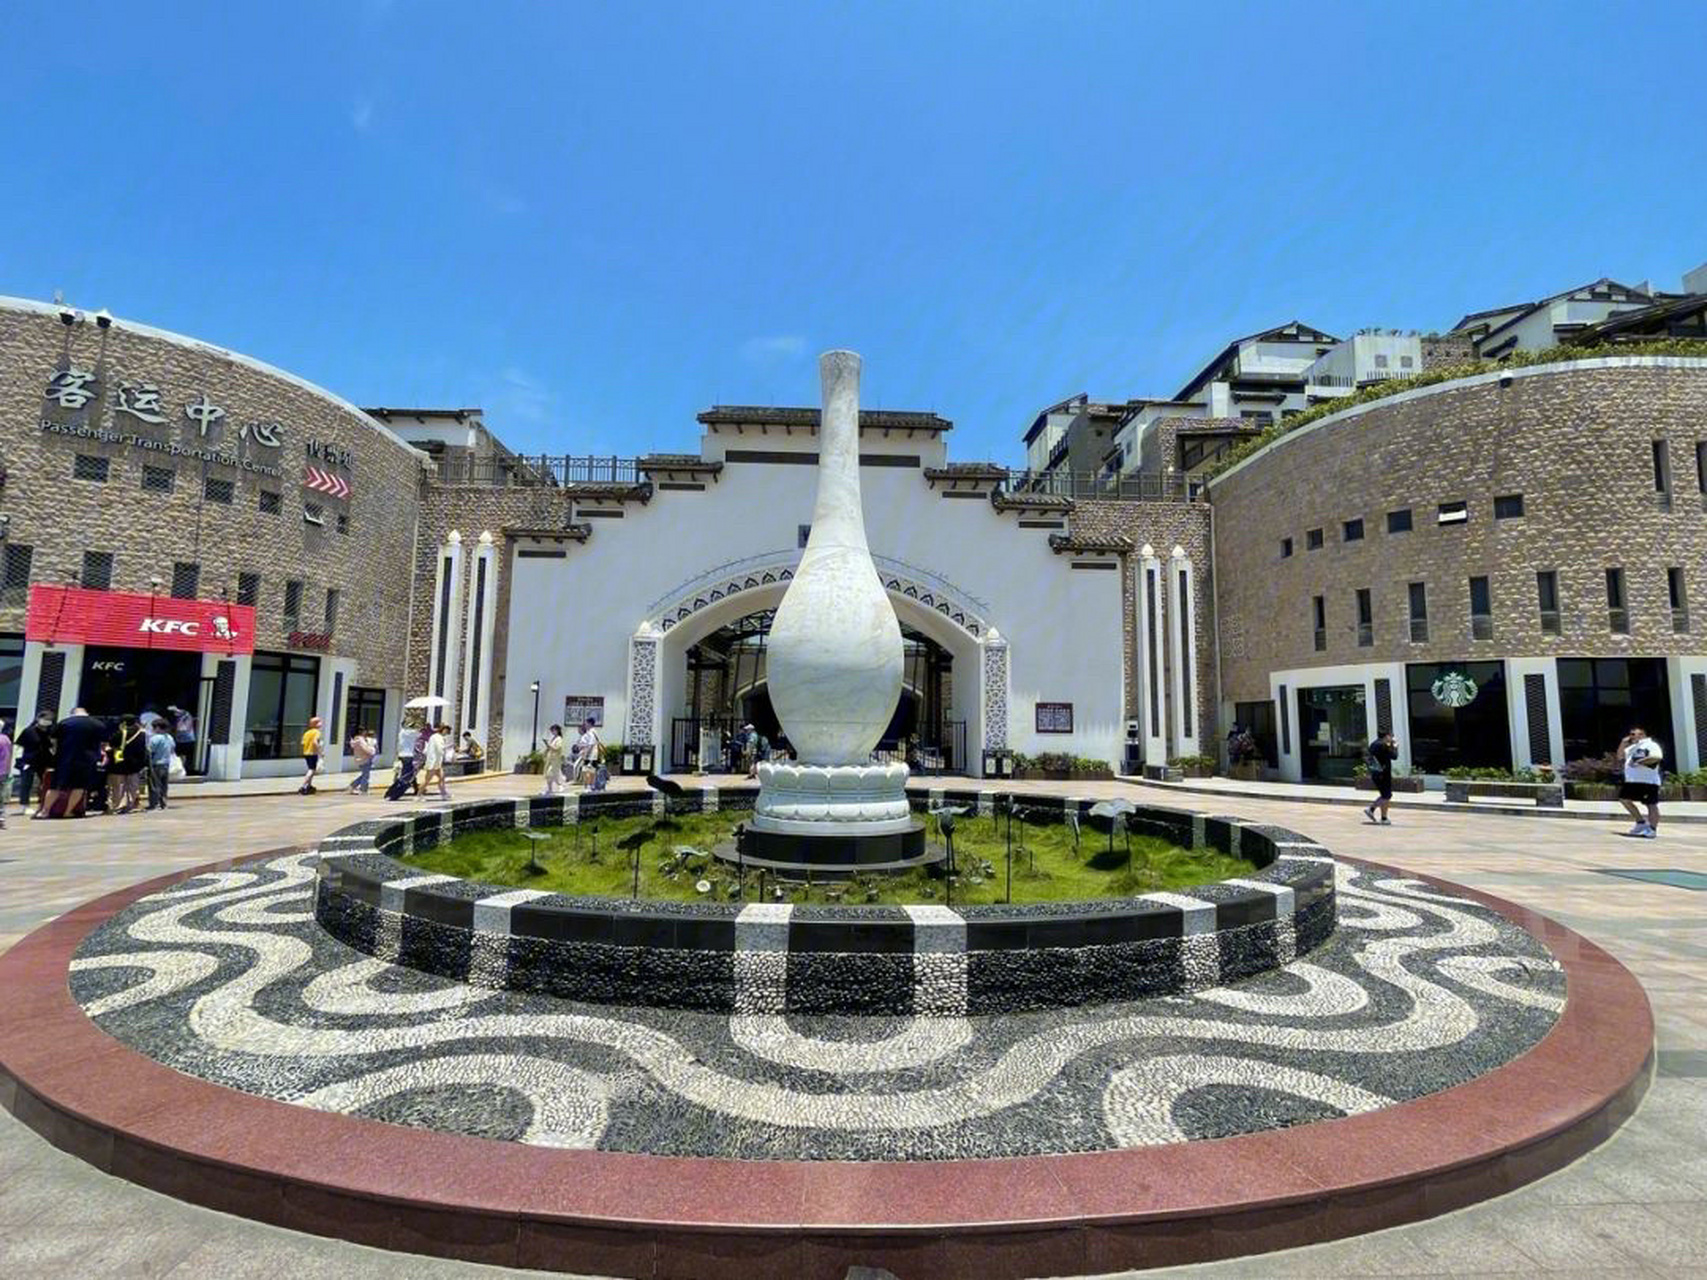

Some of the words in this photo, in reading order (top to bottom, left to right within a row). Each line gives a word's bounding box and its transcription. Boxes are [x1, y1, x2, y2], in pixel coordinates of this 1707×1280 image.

[45, 367, 285, 447] 客运中心
[41, 419, 124, 443] Passenger
[130, 433, 239, 466] Transportation
[242, 458, 283, 477] Center
[139, 618, 200, 635] KFC
[92, 660, 125, 672] KFC
